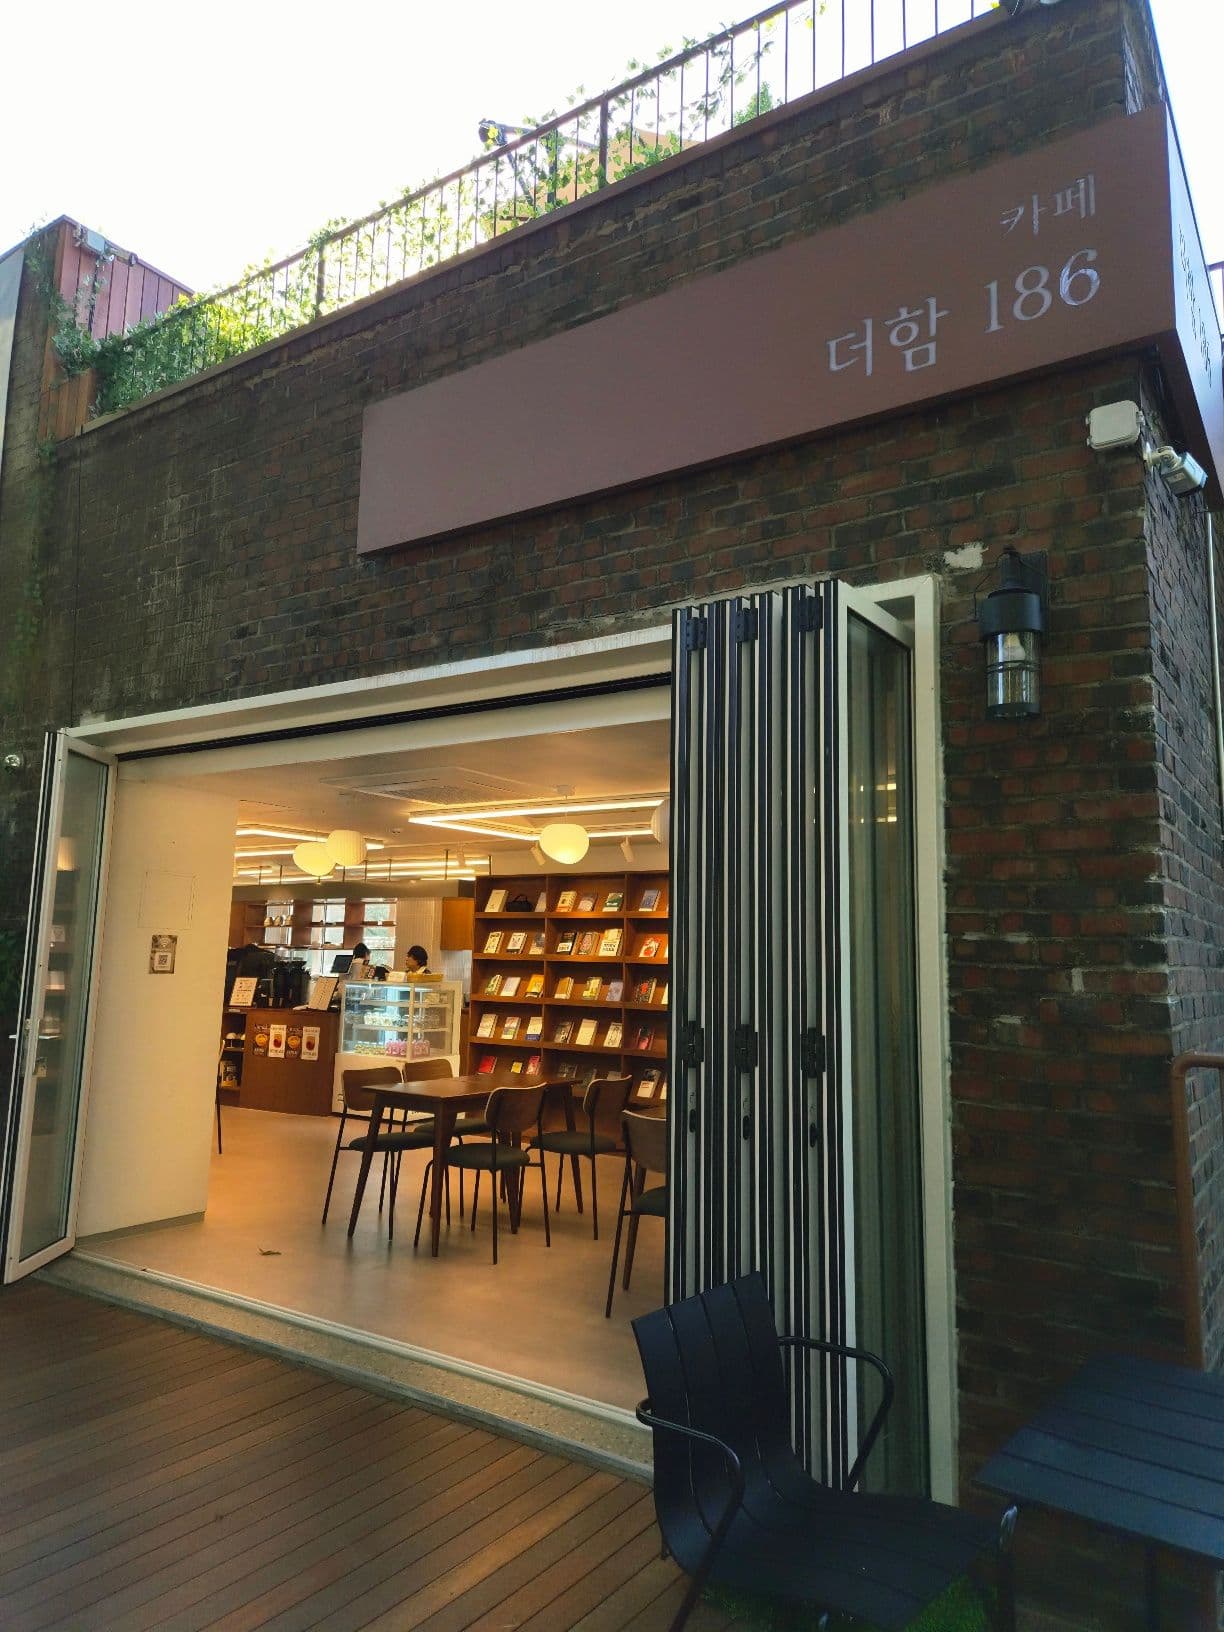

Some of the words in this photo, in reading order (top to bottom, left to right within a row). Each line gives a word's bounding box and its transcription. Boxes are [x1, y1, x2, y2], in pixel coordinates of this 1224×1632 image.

[1000, 173, 1097, 238] 카페
[826, 295, 951, 378] 더함
[983, 247, 1100, 334] 186
